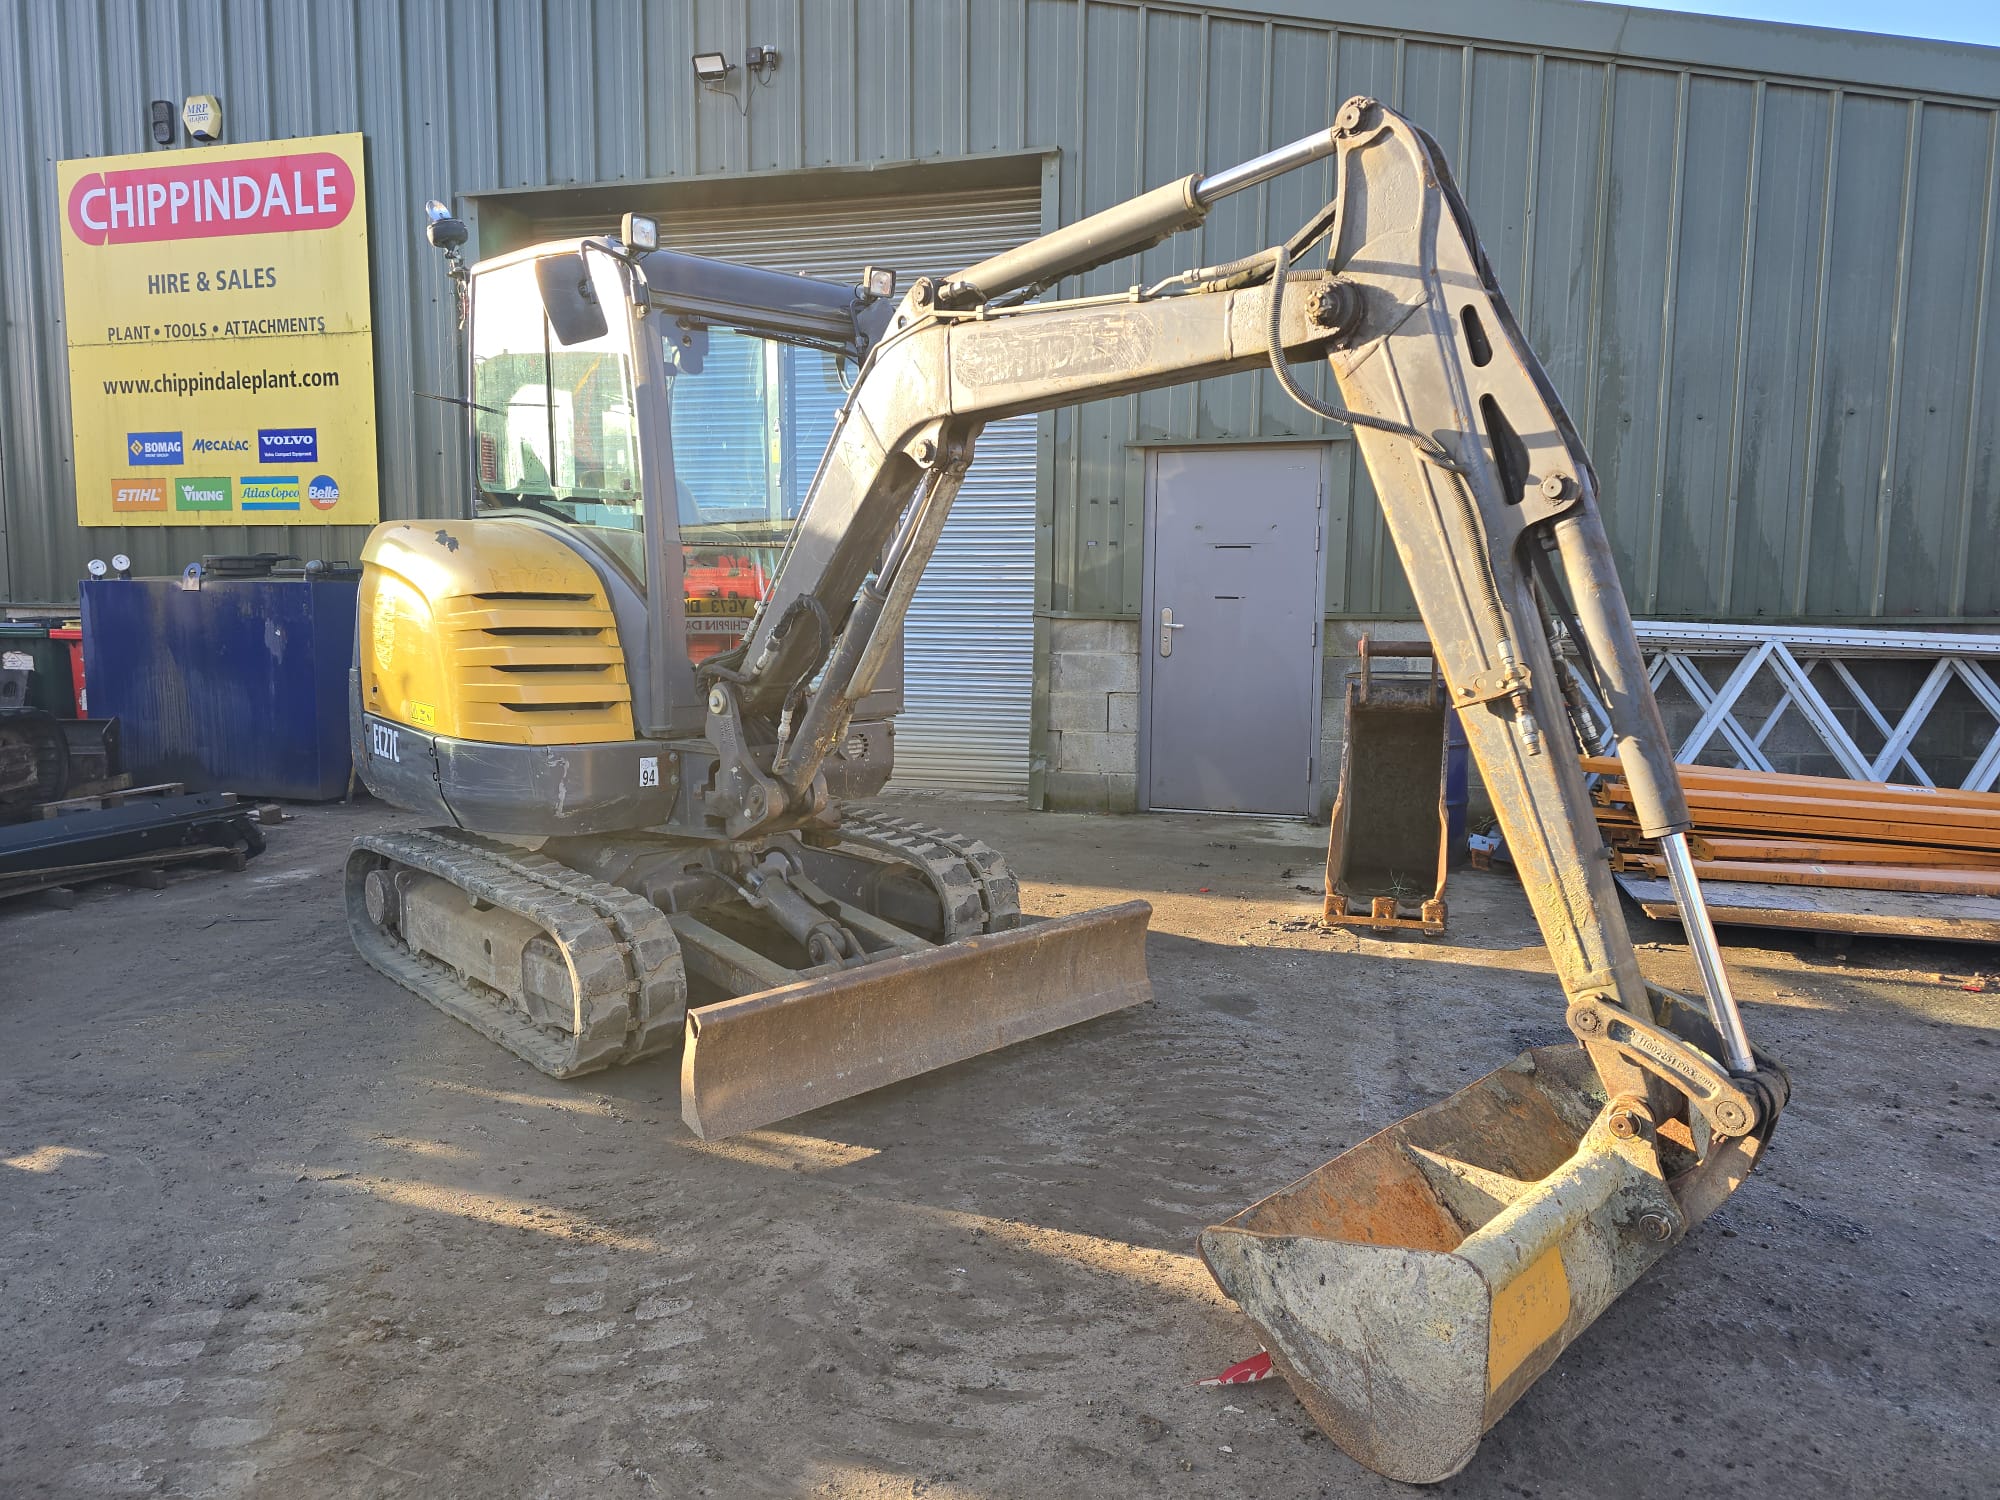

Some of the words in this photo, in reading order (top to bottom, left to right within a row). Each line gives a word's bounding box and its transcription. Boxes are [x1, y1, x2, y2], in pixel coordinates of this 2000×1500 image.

[187, 103, 208, 114] MRP
[80, 168, 337, 230] CHIPPINDALE
[148, 273, 189, 294] HIRE
[196, 271, 211, 291] &
[216, 267, 276, 290] SALES
[108, 325, 150, 341] PLANT
[164, 322, 207, 339] TOOLS
[224, 316, 326, 336] ATTACHMENTS
[103, 369, 339, 397] www.chippindaleplant.com
[144, 441, 181, 453] BOMAG
[261, 435, 314, 446] VOLVO
[184, 490, 223, 501] VIKING
[241, 487, 270, 499] Atlas
[271, 487, 299, 500] Copco
[308, 486, 339, 499] Belle
[642, 769, 656, 785] 94
